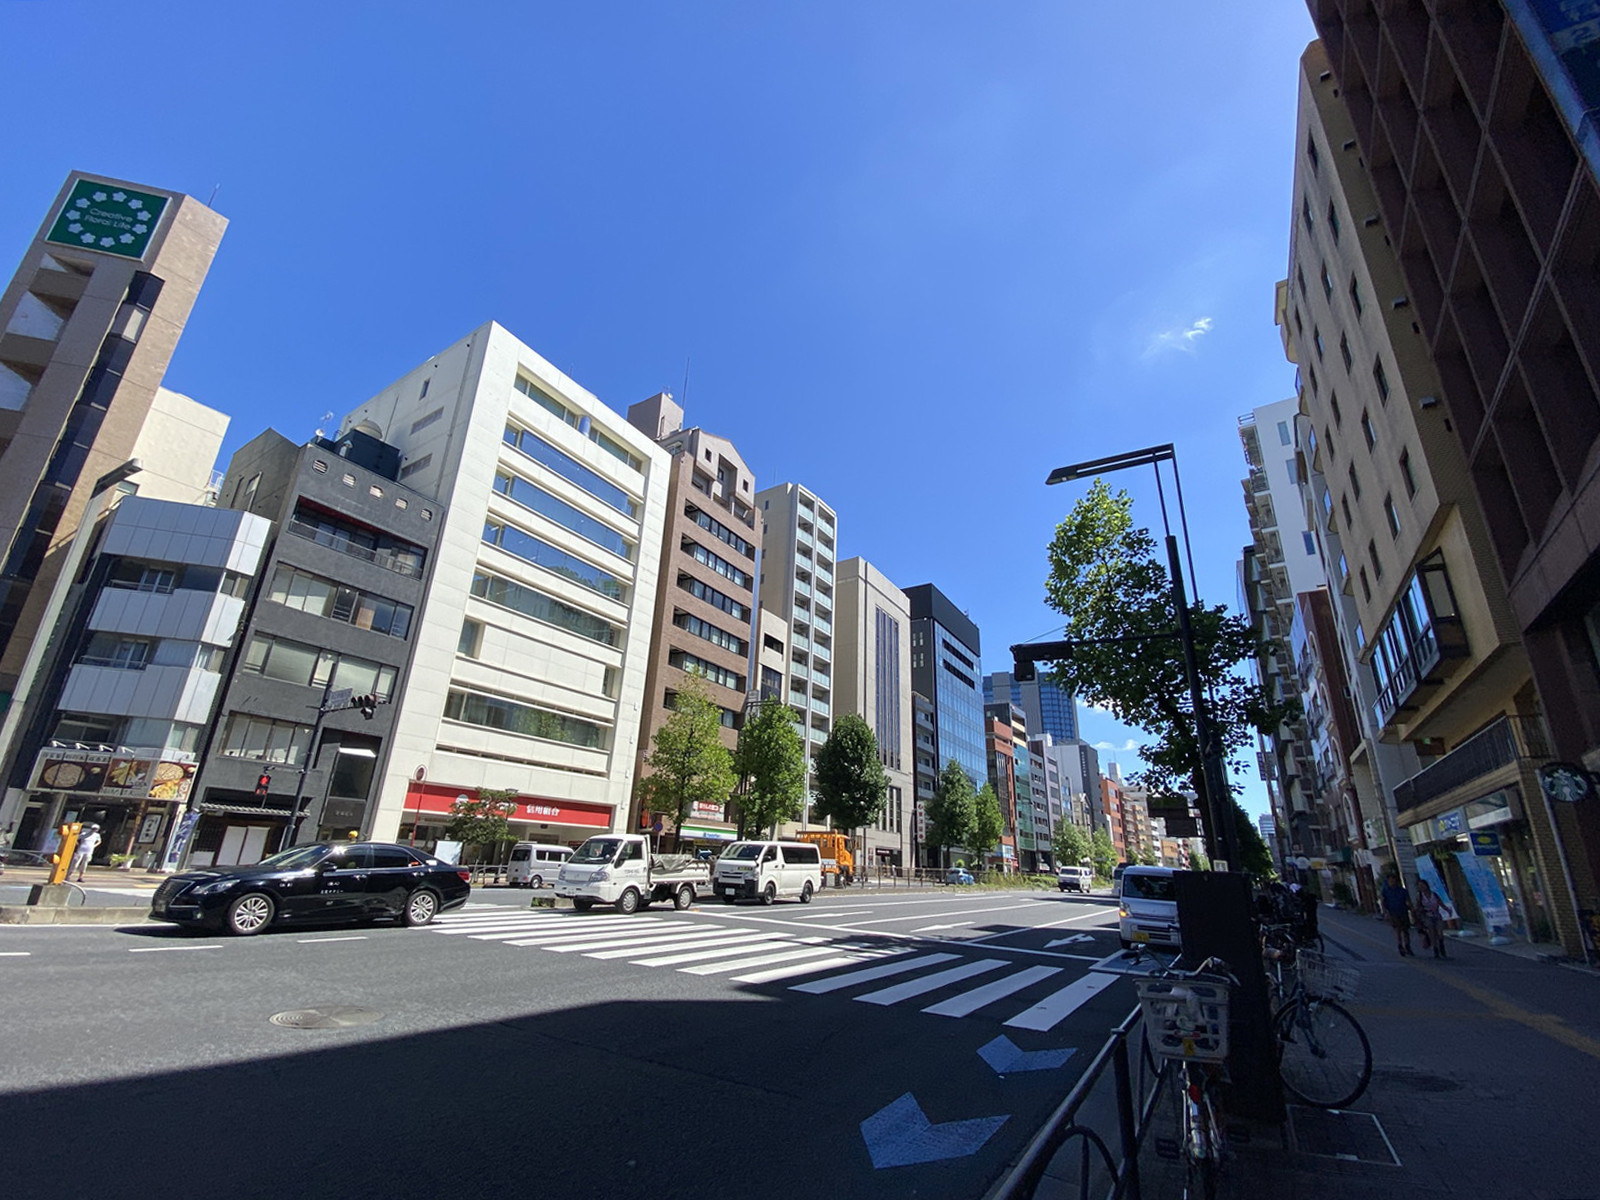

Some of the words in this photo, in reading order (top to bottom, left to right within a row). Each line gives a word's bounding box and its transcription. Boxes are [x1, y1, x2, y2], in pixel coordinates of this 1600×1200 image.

[84, 214, 112, 226] Floral
[90, 208, 133, 222] Creative
[526, 805, 560, 816] 信用組合
